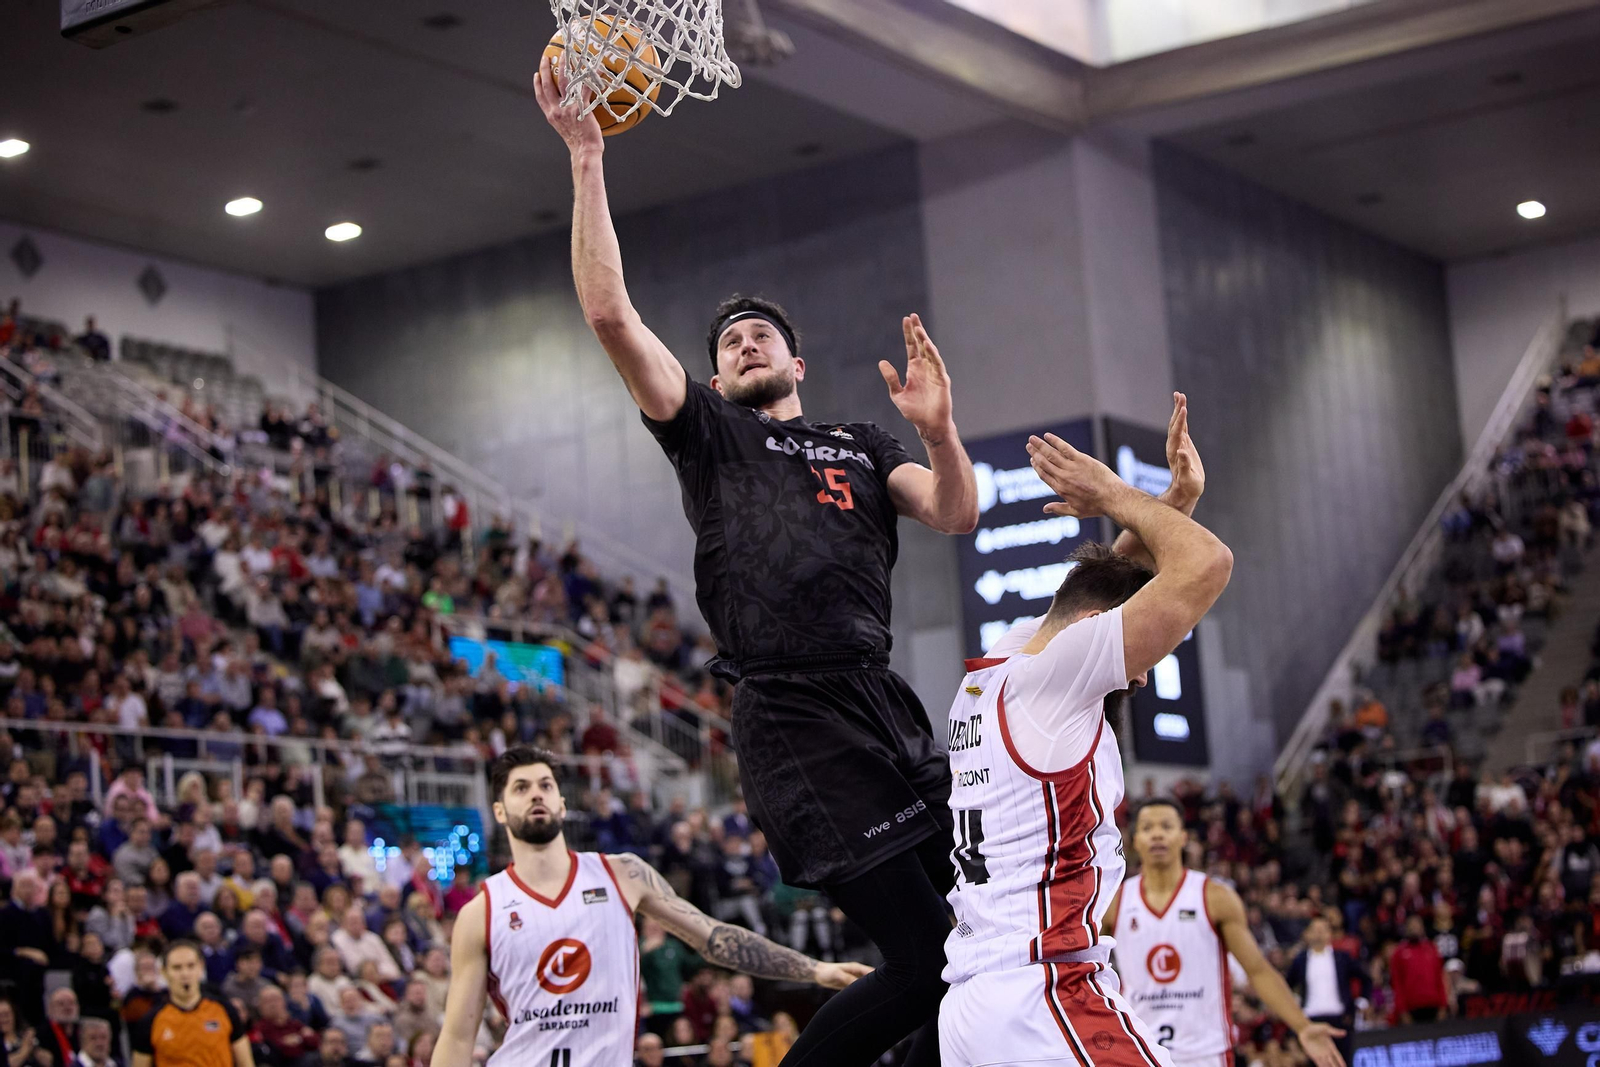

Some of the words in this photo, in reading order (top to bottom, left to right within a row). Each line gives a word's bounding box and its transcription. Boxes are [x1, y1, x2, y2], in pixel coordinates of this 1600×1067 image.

[863, 821, 891, 839] vive
[538, 1018, 590, 1032] ZARAGOZA
[1158, 1025, 1175, 1049] 2
